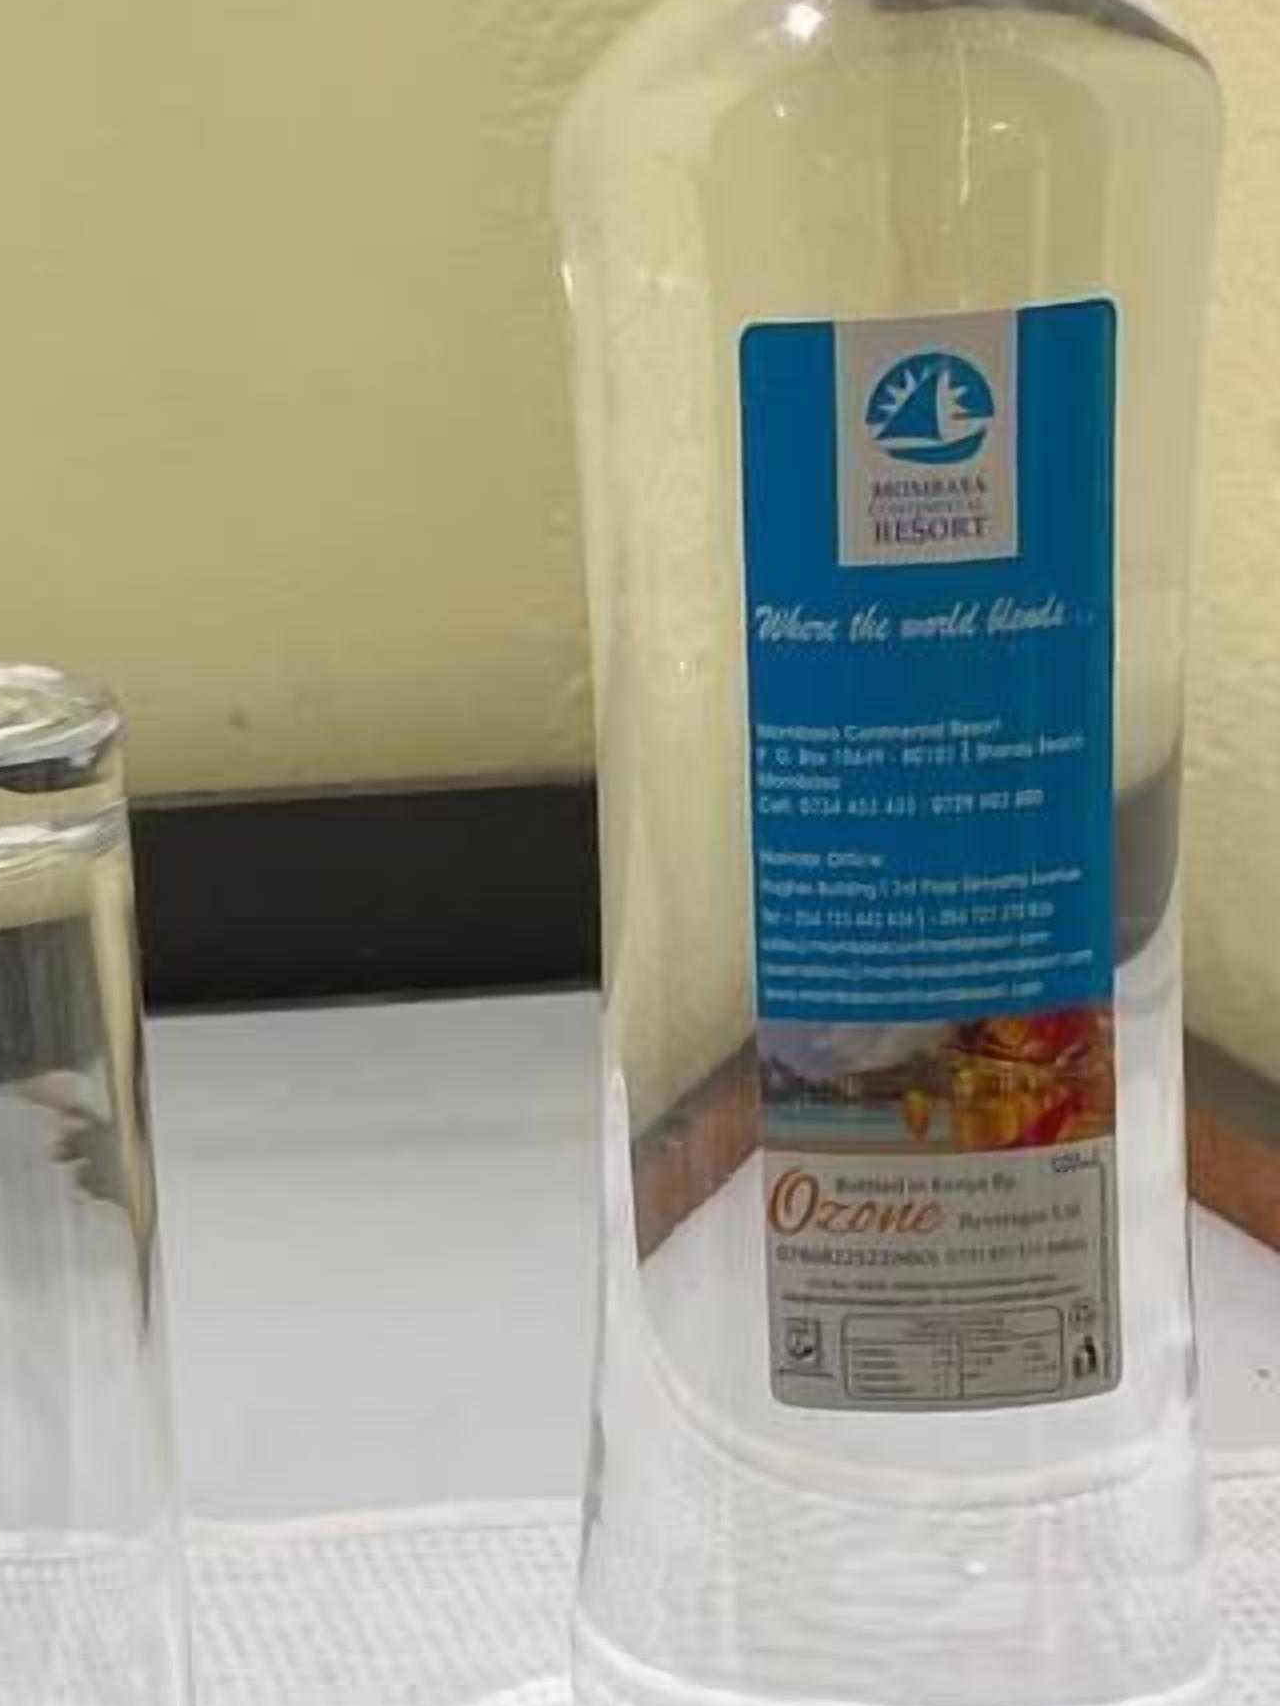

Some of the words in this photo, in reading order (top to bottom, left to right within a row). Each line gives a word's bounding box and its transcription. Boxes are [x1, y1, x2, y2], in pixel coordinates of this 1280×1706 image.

[874, 517, 991, 543] RESORT
[755, 603, 838, 641] Where
[849, 604, 890, 642] the
[900, 601, 981, 639] world
[767, 1166, 943, 1237] Ozone
